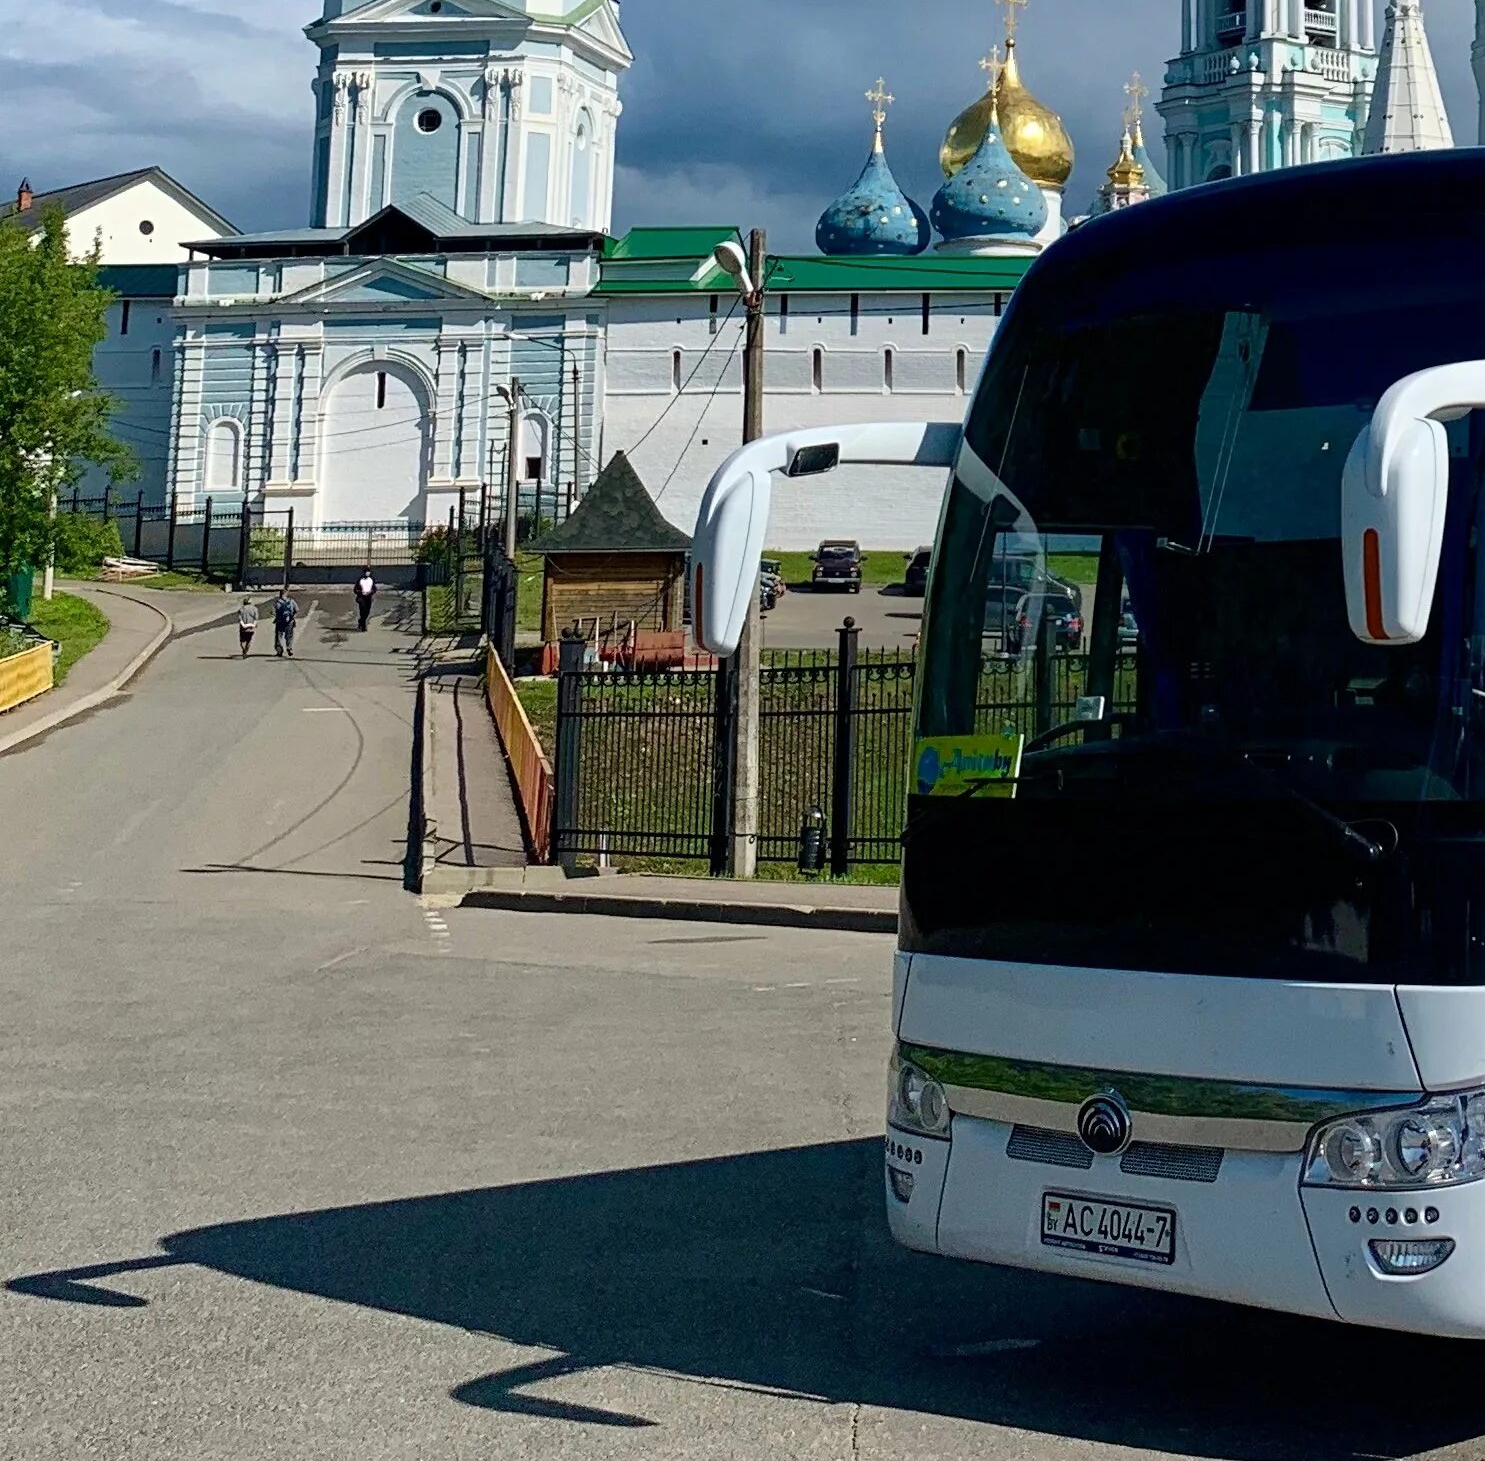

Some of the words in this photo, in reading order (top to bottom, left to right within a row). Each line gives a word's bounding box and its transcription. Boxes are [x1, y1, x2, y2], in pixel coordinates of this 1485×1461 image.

[1047, 1216, 1059, 1231] BY
[1063, 1203, 1094, 1237] AC
[1098, 1207, 1168, 1248] 4044-7
